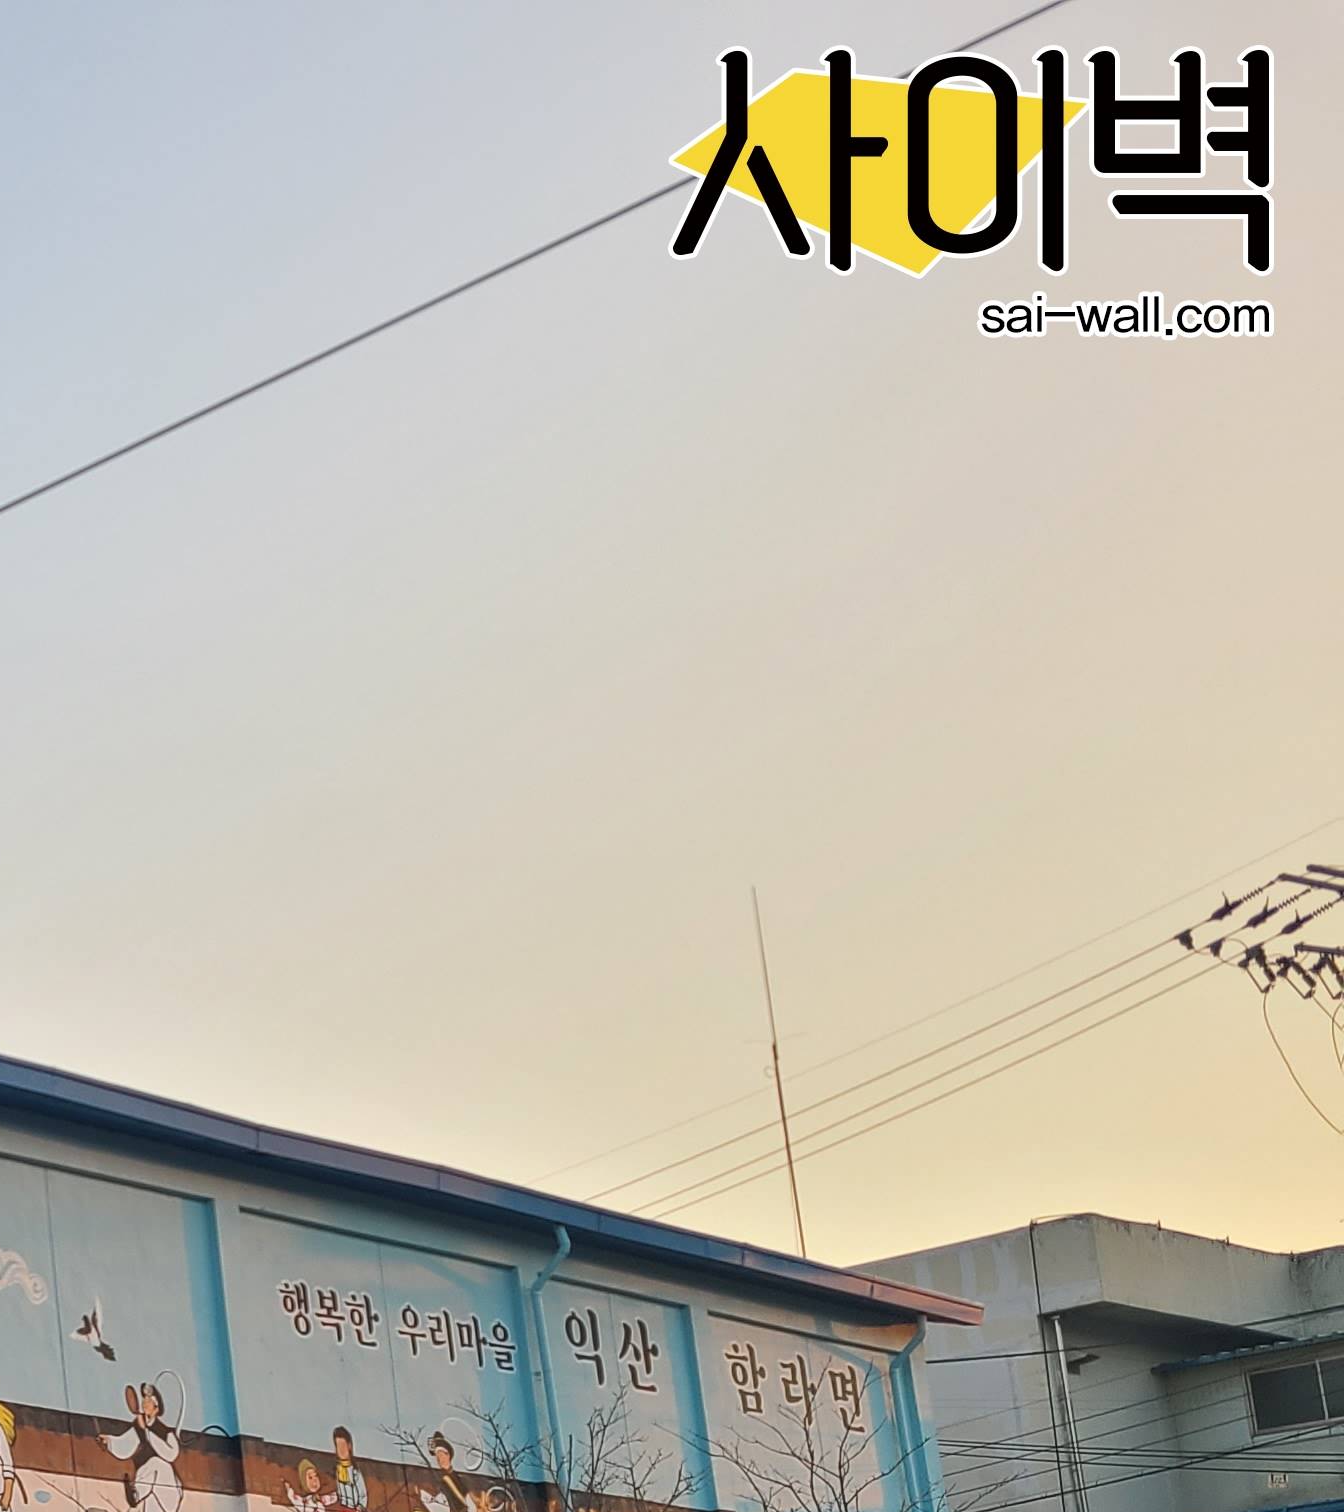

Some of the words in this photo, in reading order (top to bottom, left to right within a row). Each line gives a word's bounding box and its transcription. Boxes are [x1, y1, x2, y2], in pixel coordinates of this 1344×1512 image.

[278, 1281, 380, 1347] 행복한
[397, 1304, 517, 1371] 우리마을
[564, 1308, 659, 1392] 익산
[724, 1342, 866, 1433] 함라면
